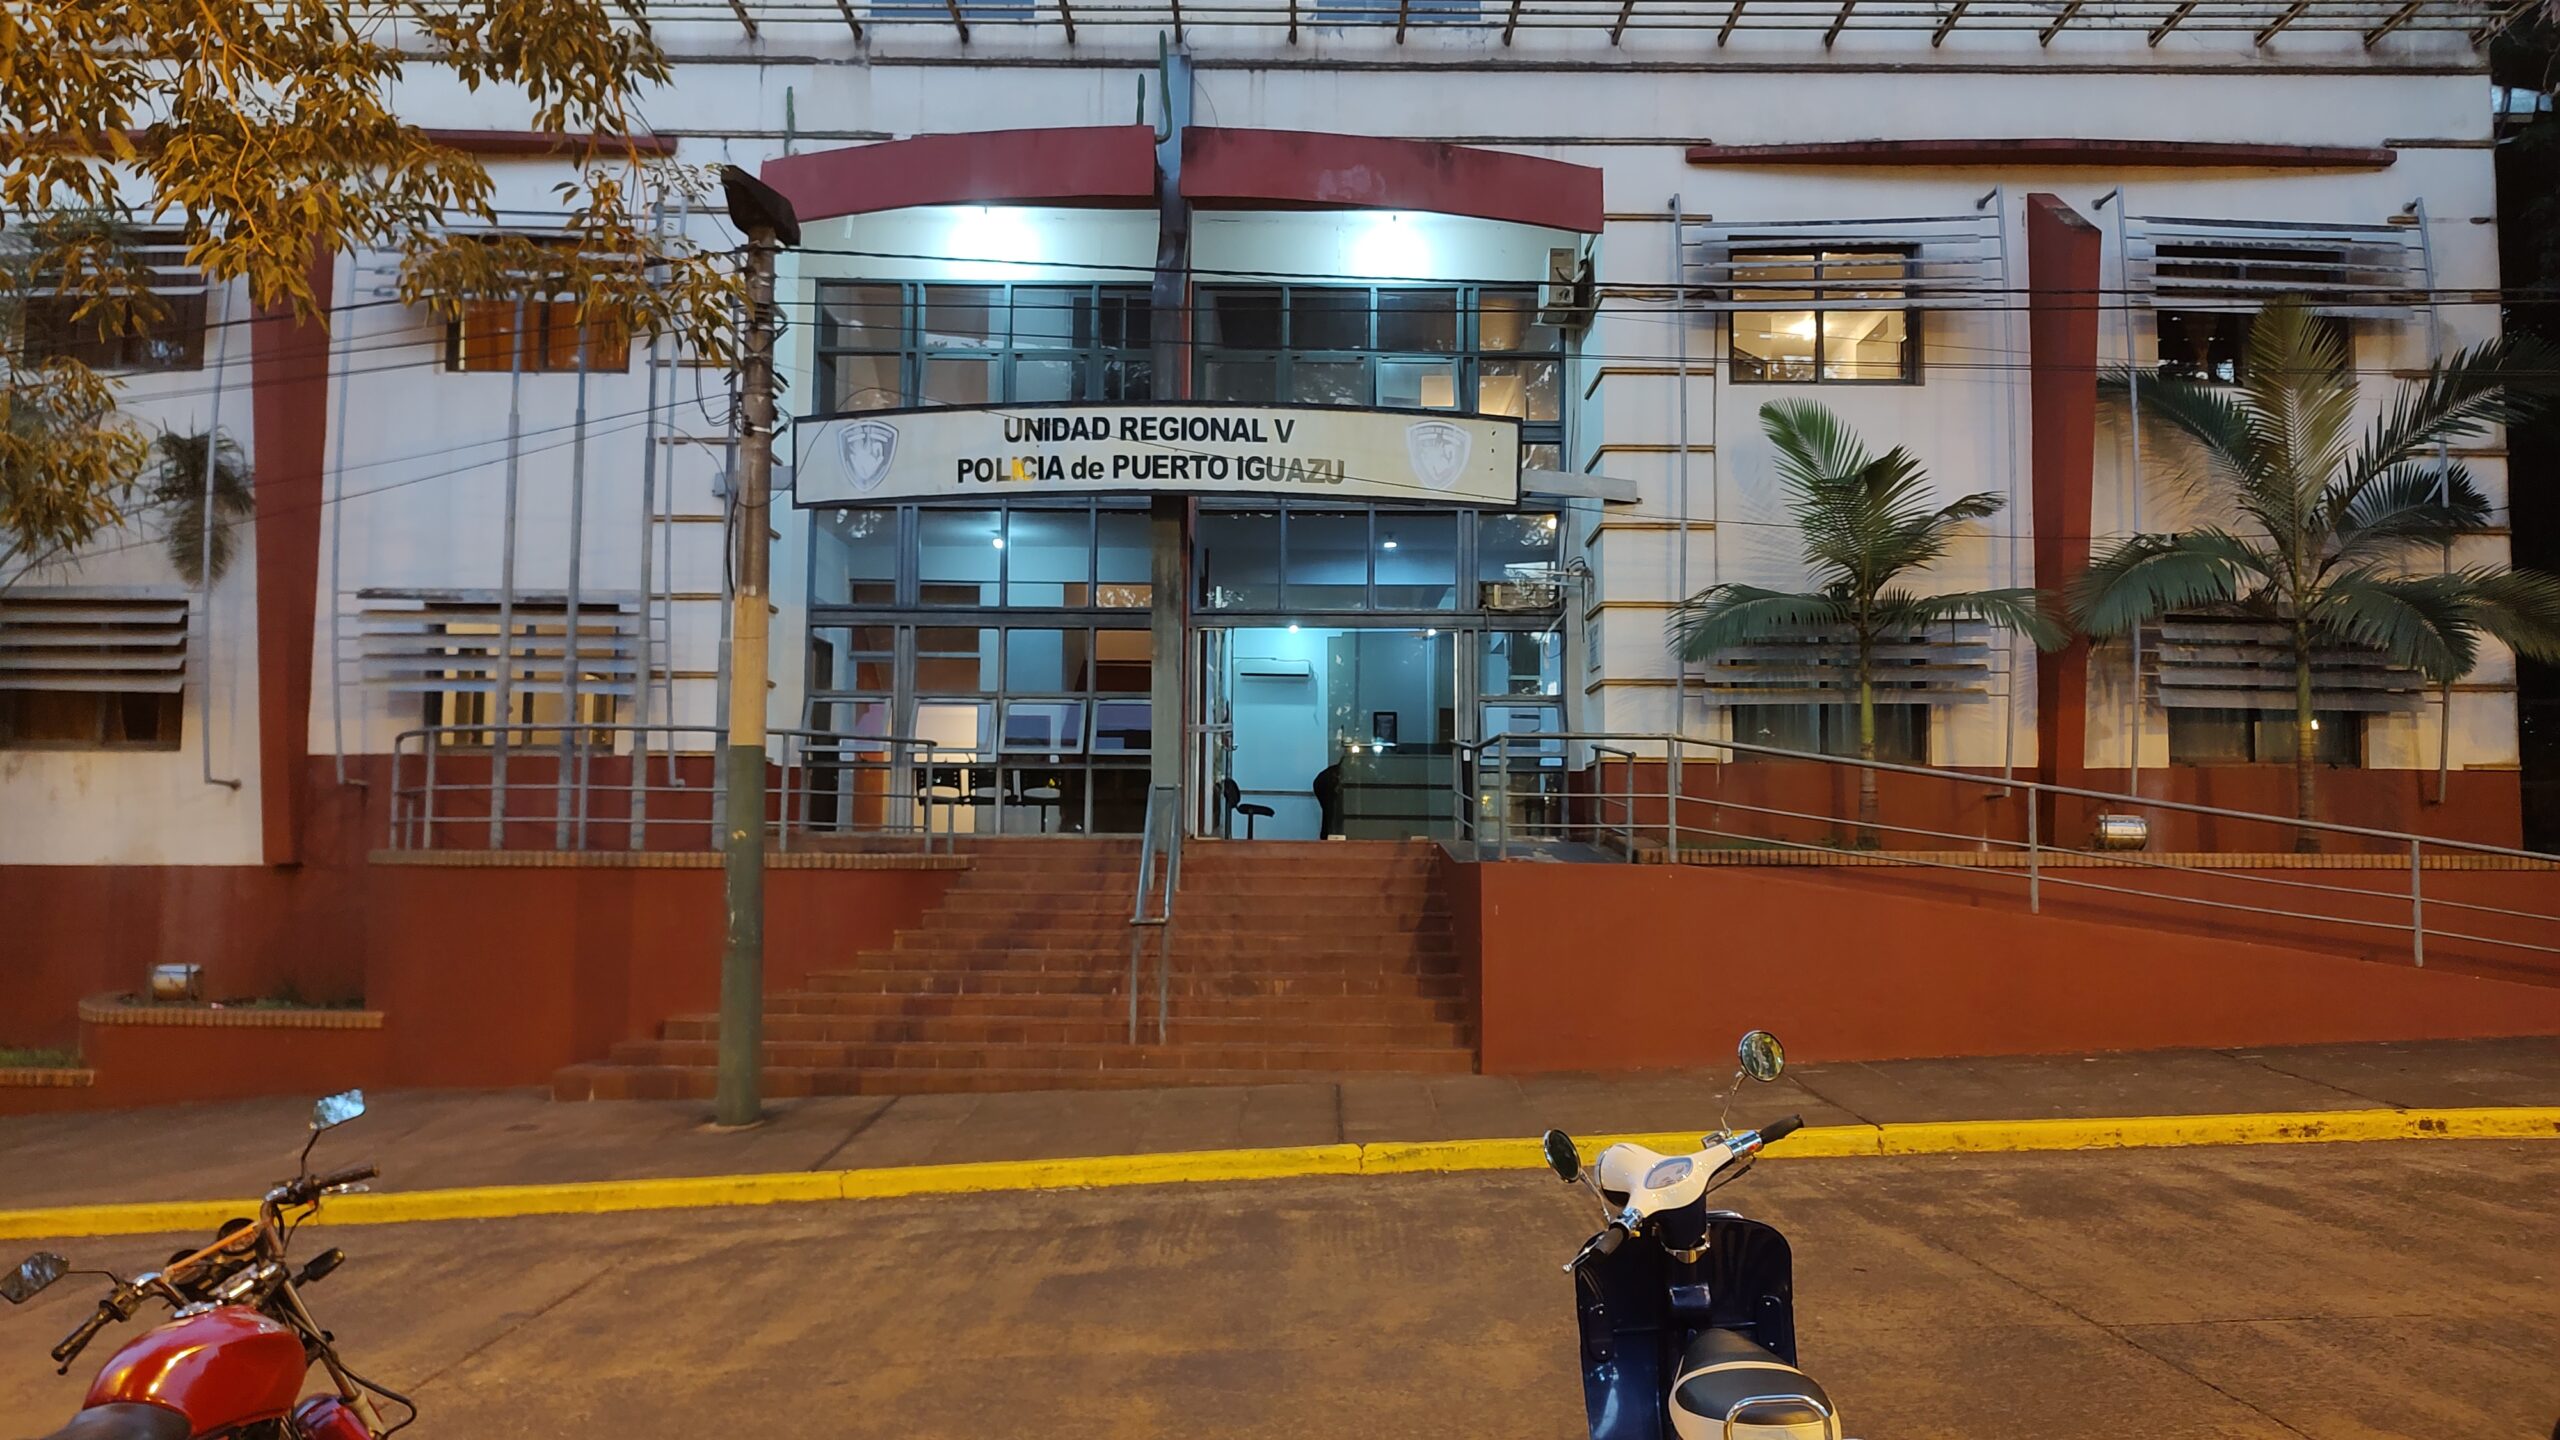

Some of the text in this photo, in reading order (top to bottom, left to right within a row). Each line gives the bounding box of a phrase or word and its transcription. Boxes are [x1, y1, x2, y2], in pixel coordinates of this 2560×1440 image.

[1004, 416, 1295, 443] UNIDAD REGIONAL V
[957, 454, 1345, 485] POLICIA de PUERTO IGUAZU
